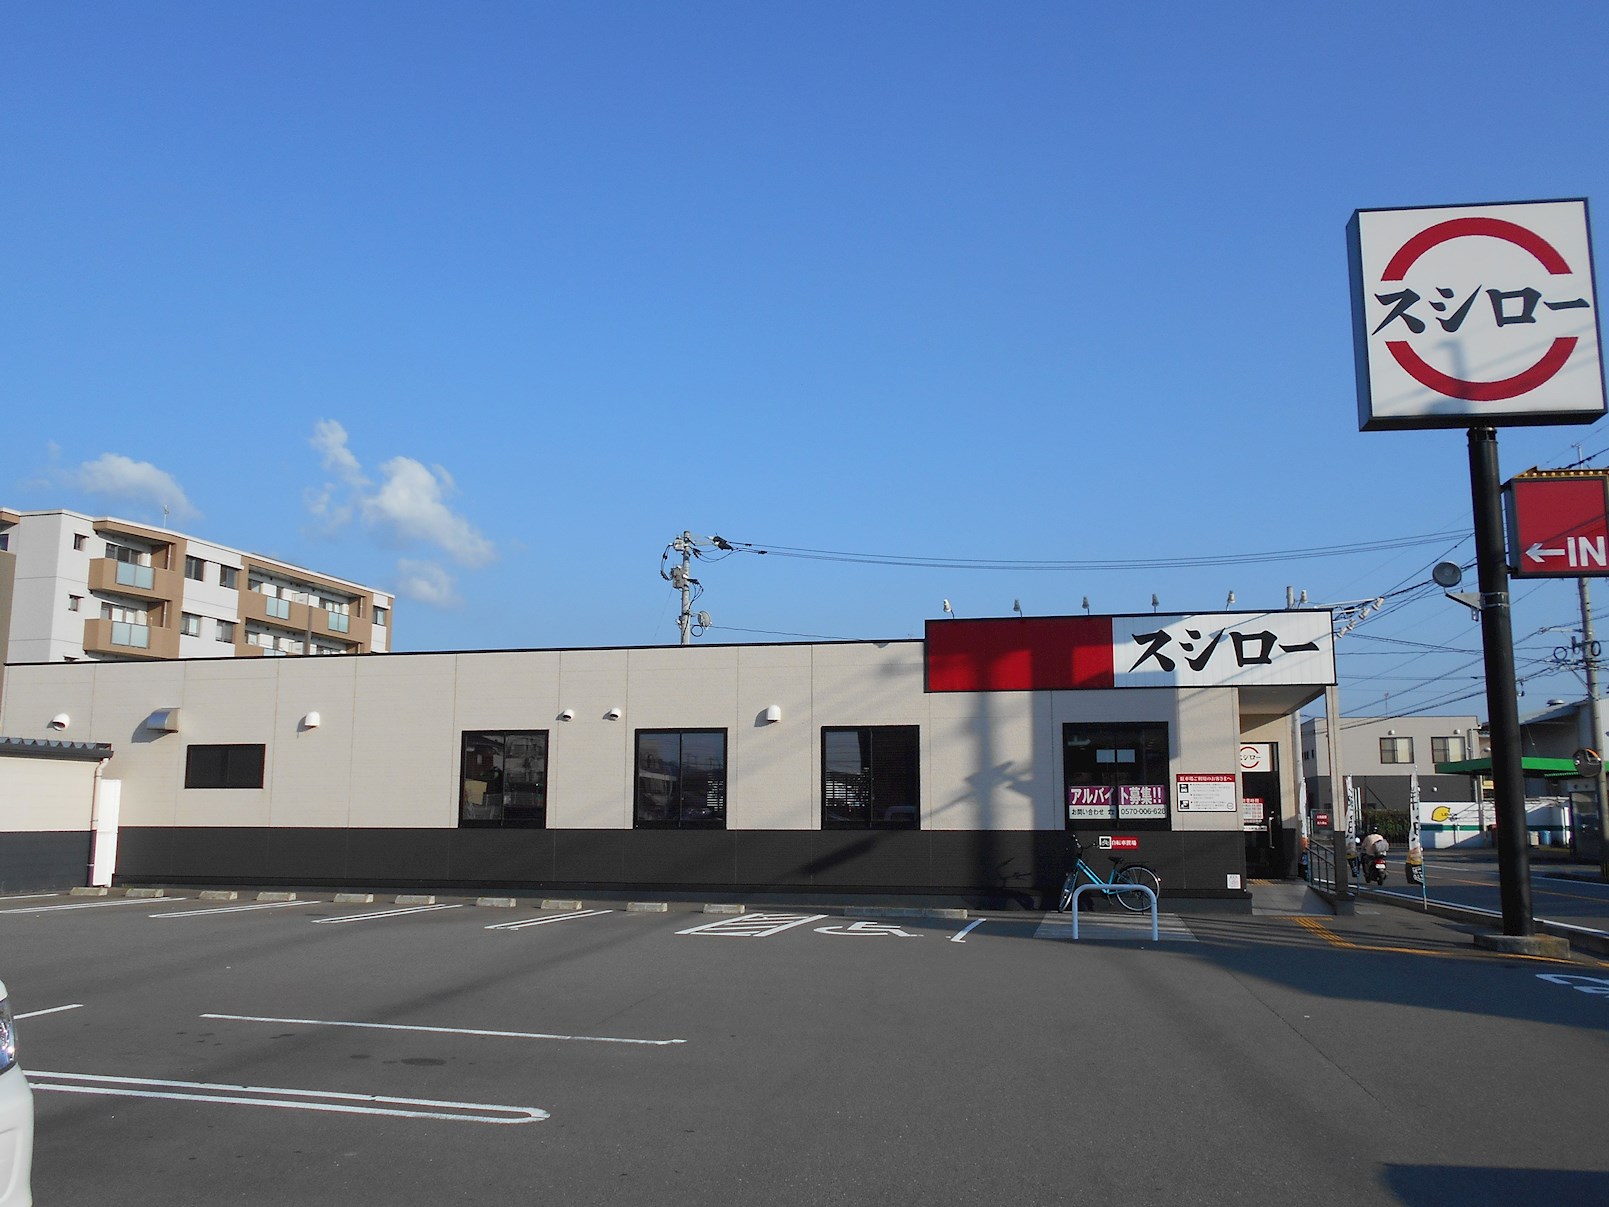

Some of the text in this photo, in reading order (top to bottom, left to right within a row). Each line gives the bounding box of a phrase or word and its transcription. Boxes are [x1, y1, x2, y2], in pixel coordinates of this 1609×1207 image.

[1371, 284, 1590, 335] スシロー
[1567, 536, 1607, 567] IN
[1128, 627, 1320, 673] スシロー
